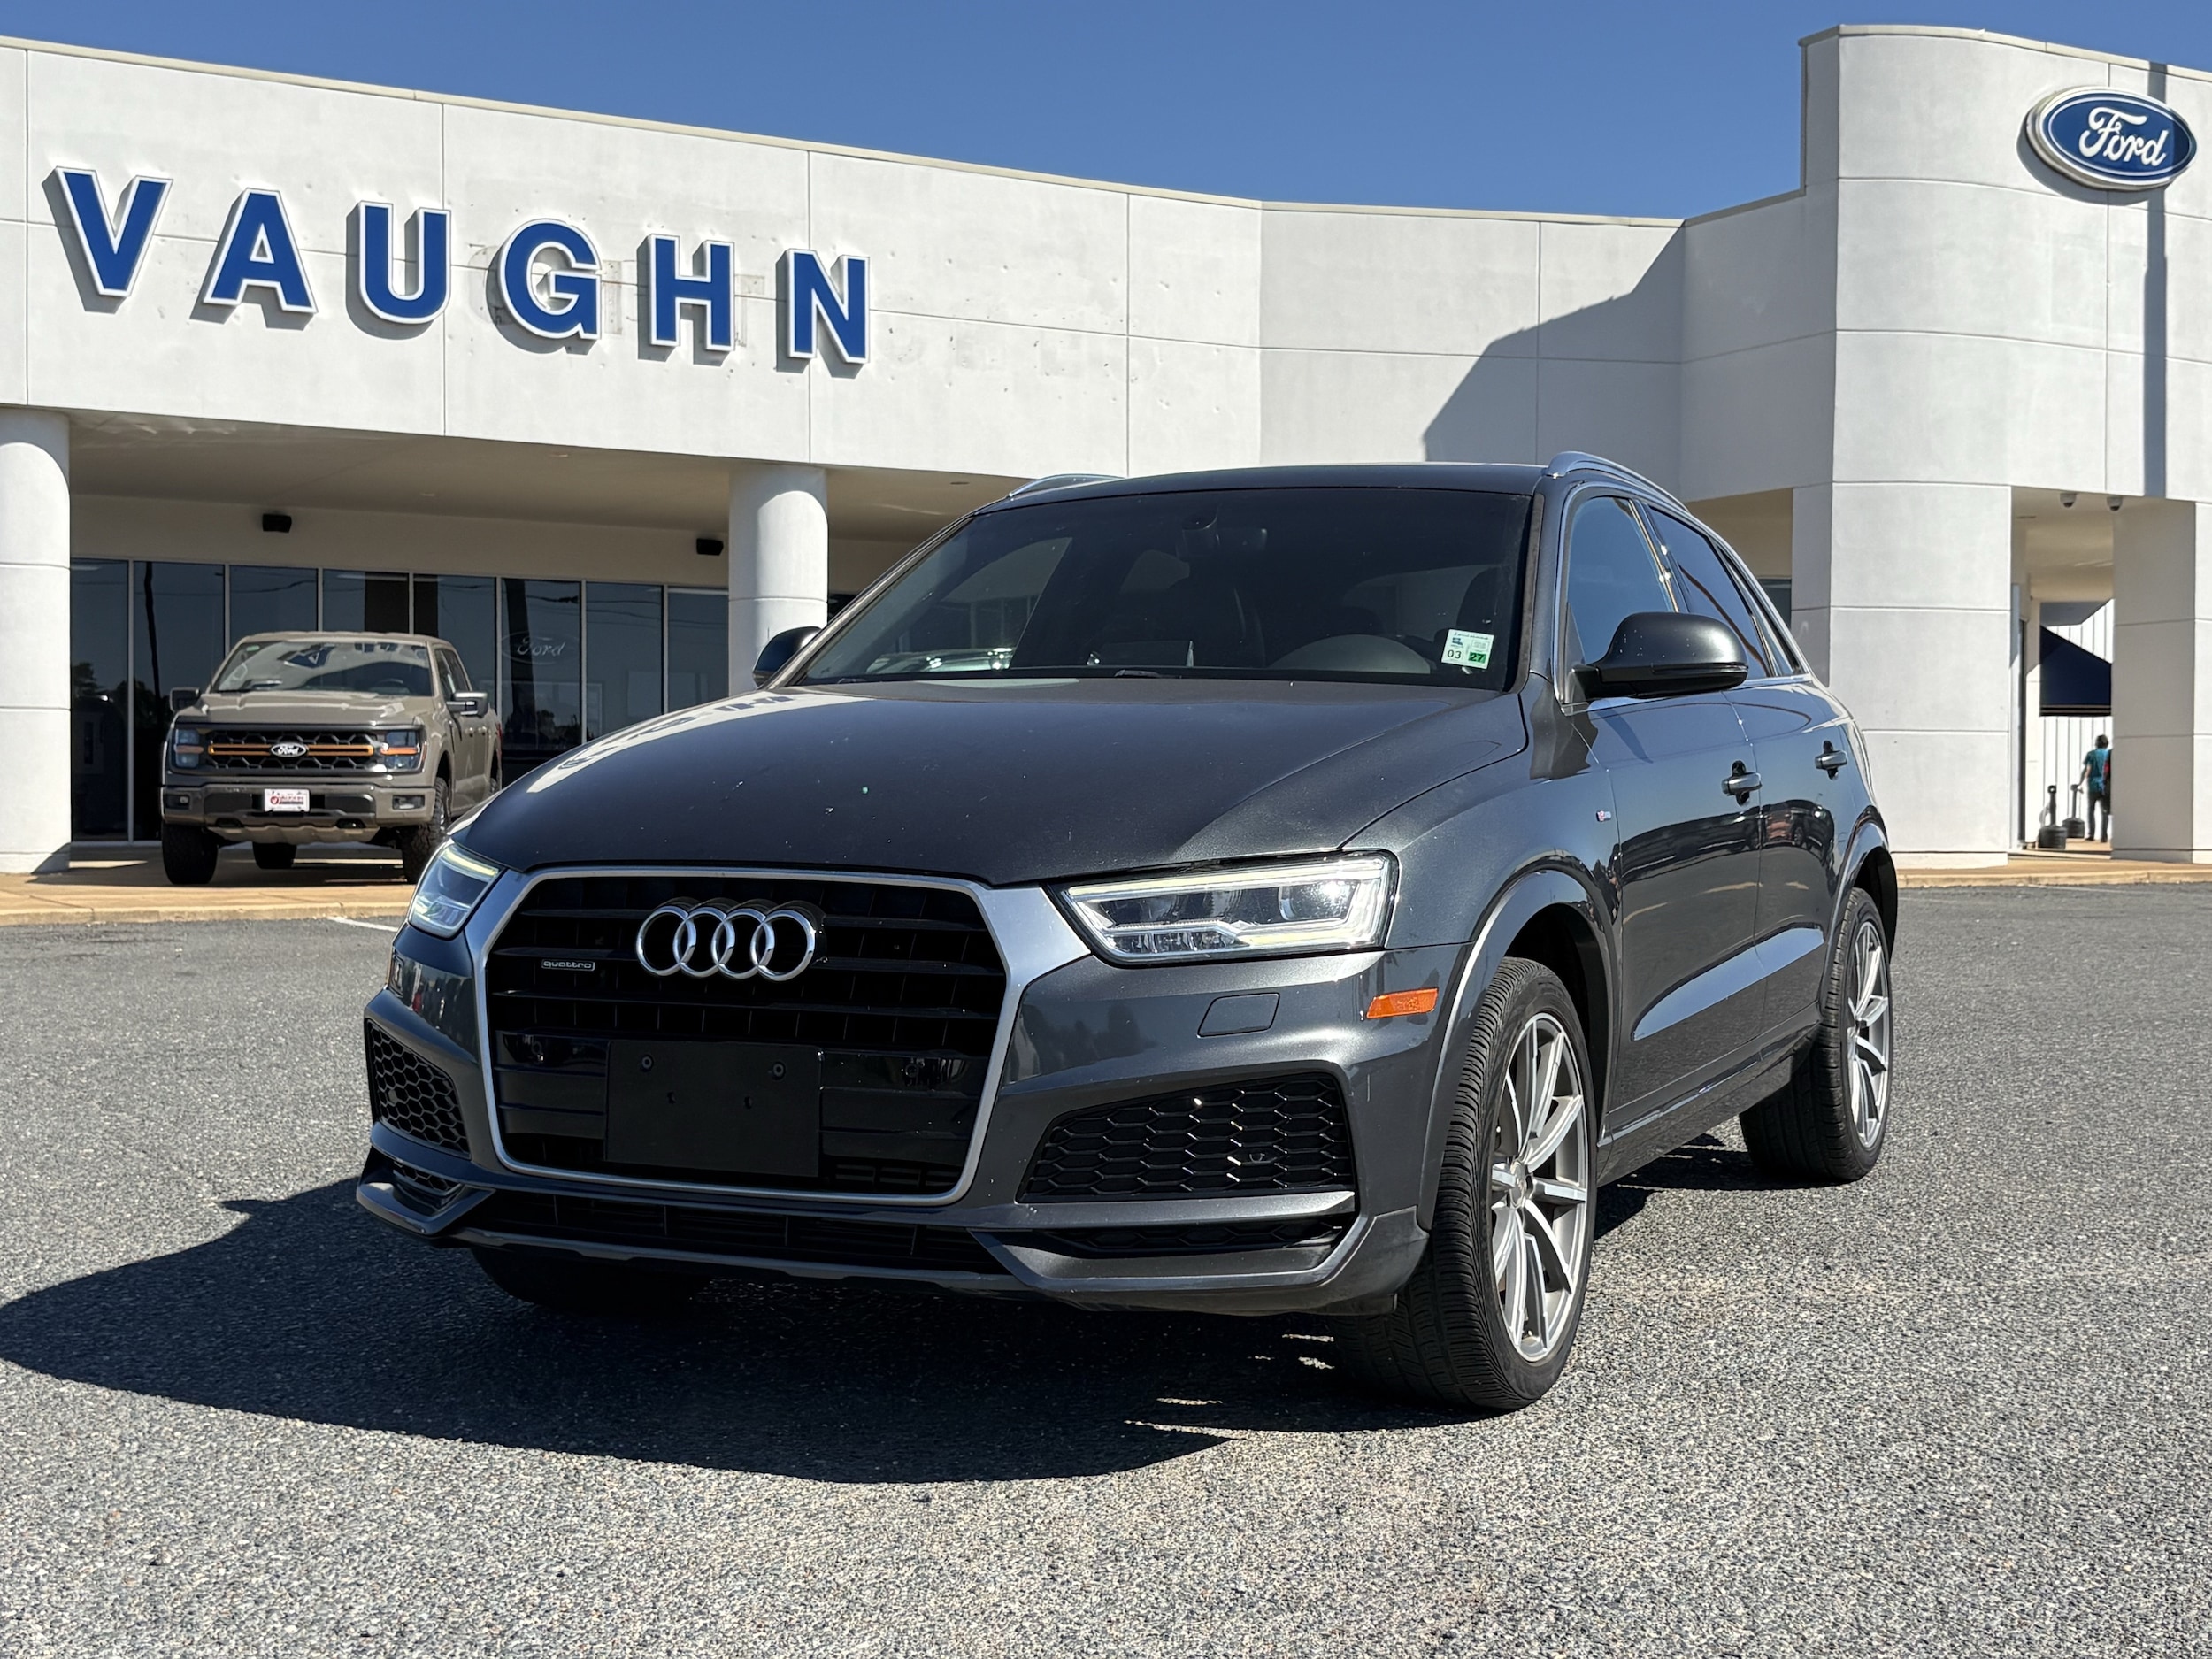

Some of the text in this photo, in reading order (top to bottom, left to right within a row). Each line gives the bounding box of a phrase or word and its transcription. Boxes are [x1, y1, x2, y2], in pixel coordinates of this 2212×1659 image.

[2078, 106, 2169, 167] Ford
[53, 165, 870, 365] VAUGHN
[517, 636, 566, 657] Ford
[1447, 649, 1485, 664] 03 27
[542, 960, 592, 969] quattro
